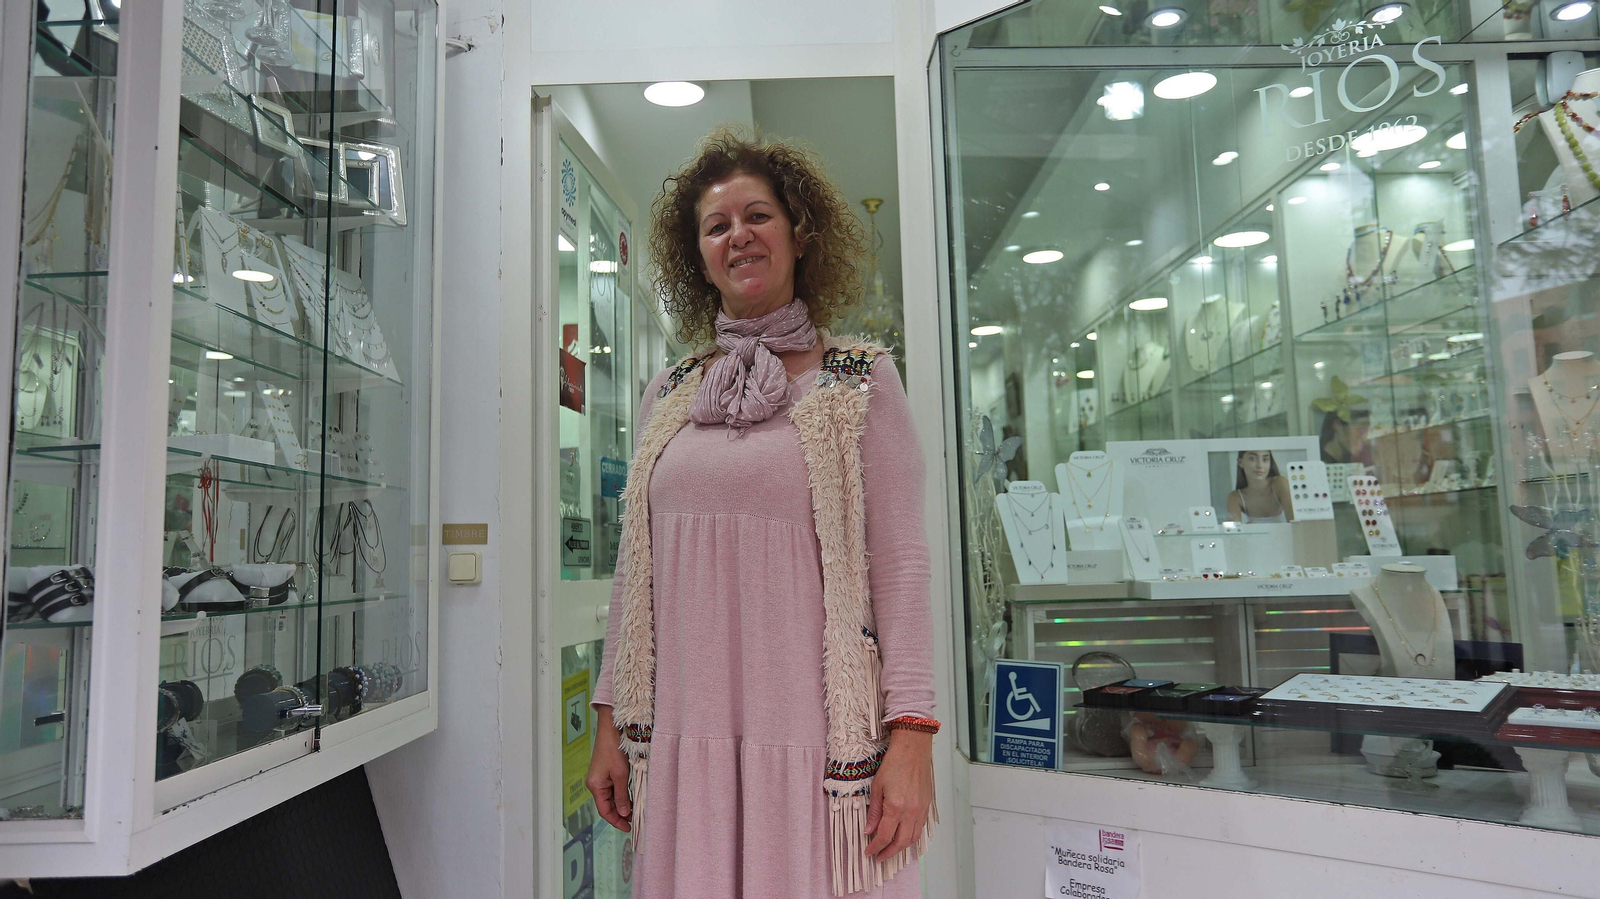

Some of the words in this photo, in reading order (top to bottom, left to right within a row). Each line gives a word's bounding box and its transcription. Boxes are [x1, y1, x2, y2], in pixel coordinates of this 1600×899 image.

[1301, 33, 1385, 74] JOYERIA
[1253, 35, 1447, 137] RIOS
[1286, 130, 1359, 163] DESDE
[1130, 456, 1163, 465] VICTORIA
[1164, 455, 1187, 464] CRUZ
[444, 530, 485, 538] TIMBRE
[173, 635, 236, 681] RIOS
[1000, 743, 1051, 755] DISCAPACITADOS
[1007, 738, 1028, 746] RAMPA
[1020, 752, 1048, 761] INTERIOR
[1102, 829, 1125, 839] bandera
[1058, 856, 1092, 870] Bandera
[1088, 854, 1125, 868] solidaria
[1070, 878, 1106, 895] Empresa
